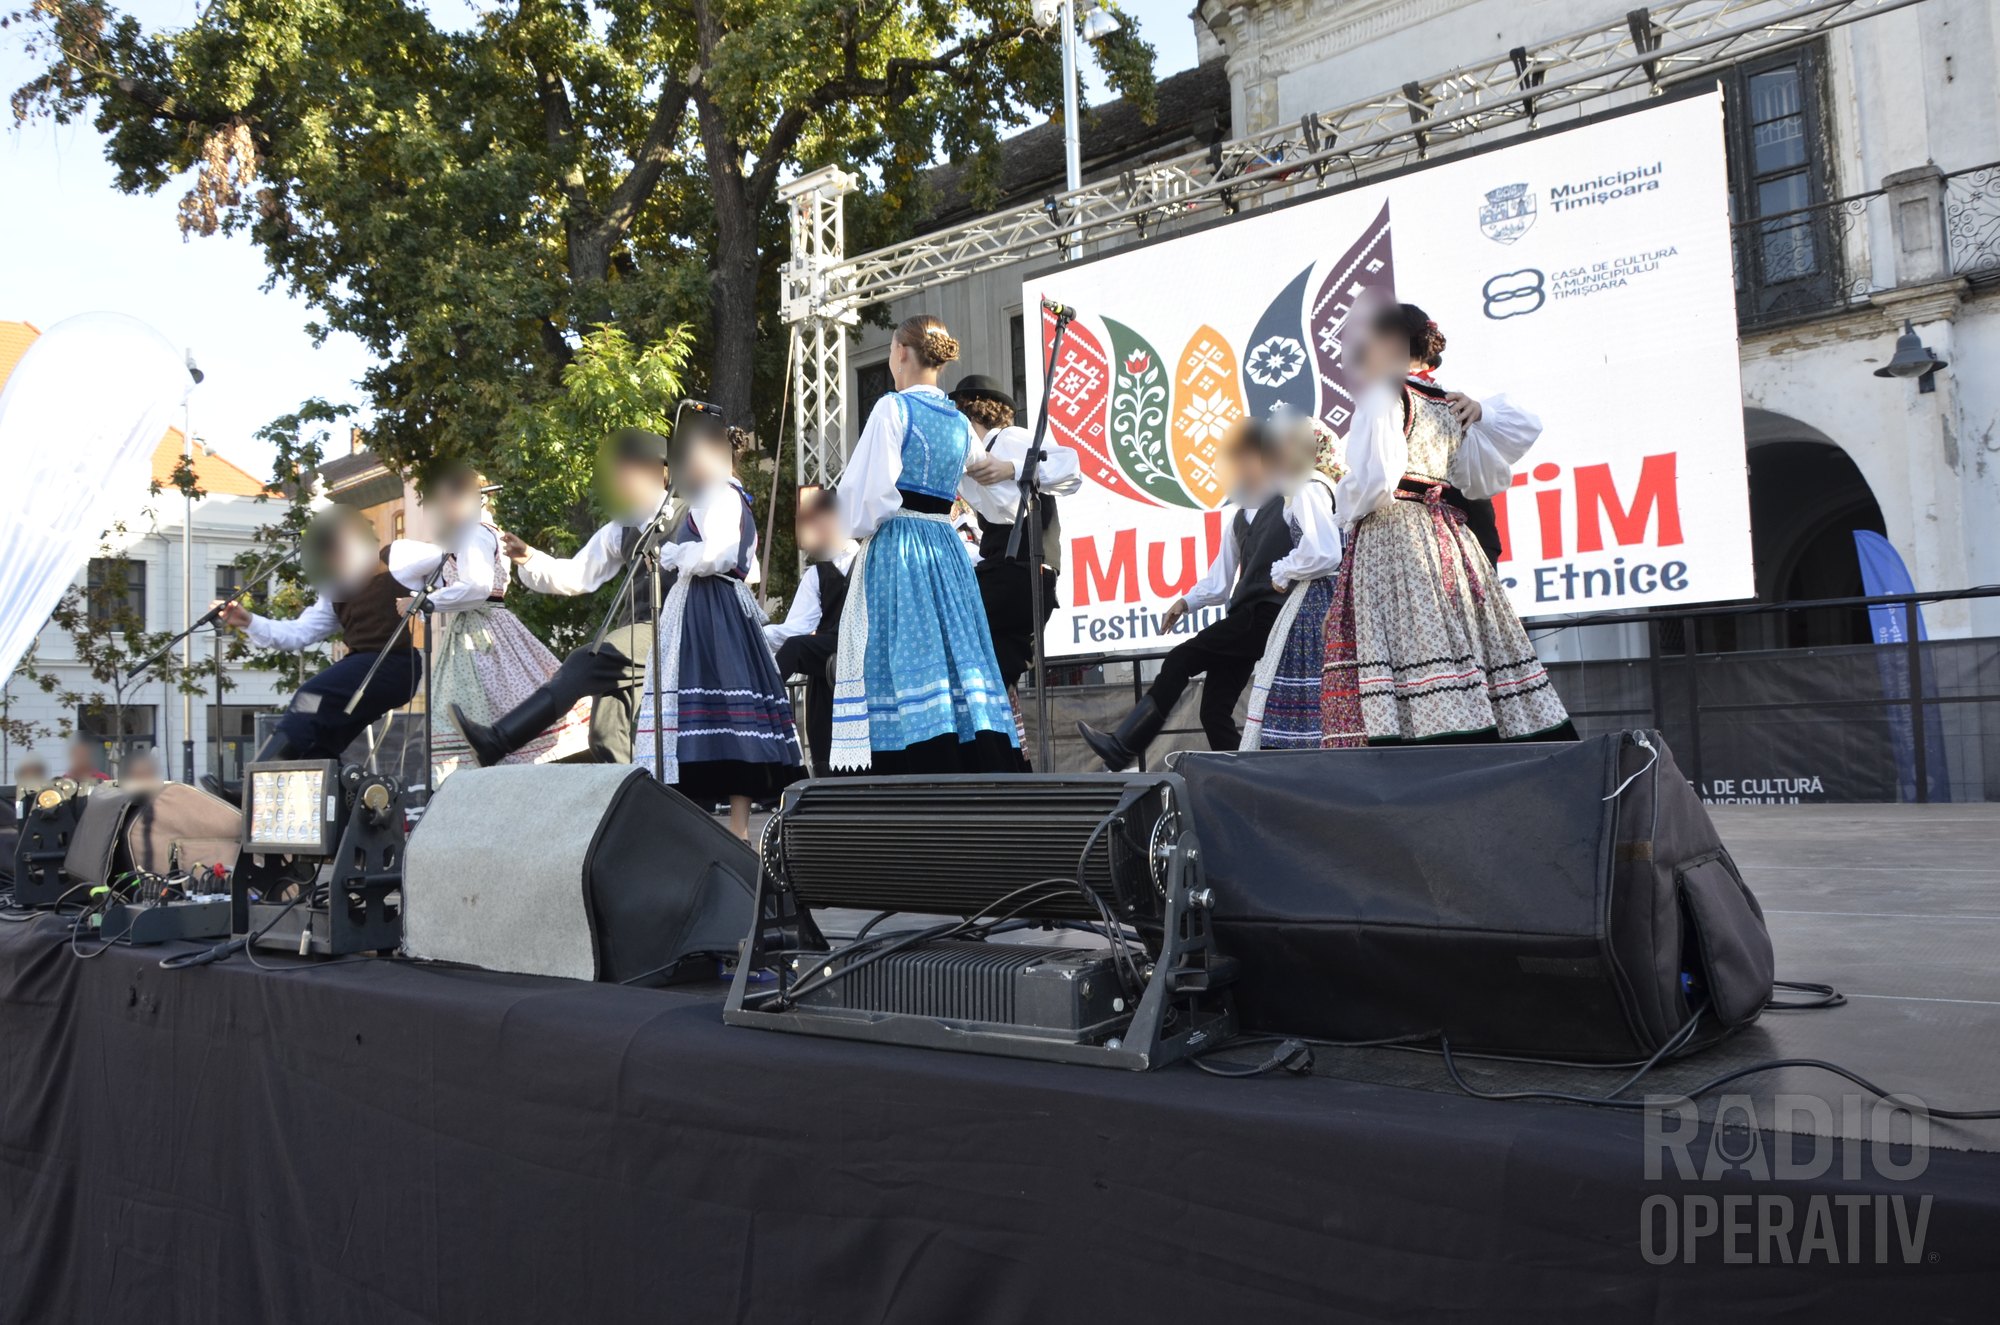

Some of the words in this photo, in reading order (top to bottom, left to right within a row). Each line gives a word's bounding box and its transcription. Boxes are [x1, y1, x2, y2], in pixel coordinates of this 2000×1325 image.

[1550, 161, 1662, 200] Municipiul
[1550, 179, 1660, 213] Timișoara
[1551, 267, 1587, 281] CASA
[1592, 261, 1609, 273] DE
[1552, 282, 1561, 292] A
[1564, 261, 1659, 289] MUNICIPIULUI
[1552, 278, 1628, 300] TIMIȘOARA
[1071, 511, 1223, 607] Mul
[1072, 605, 1223, 644] Festivalu
[1534, 557, 1689, 602] Etnice
[1714, 779, 1737, 795] DE
[1741, 775, 1824, 795] CULTURĂ
